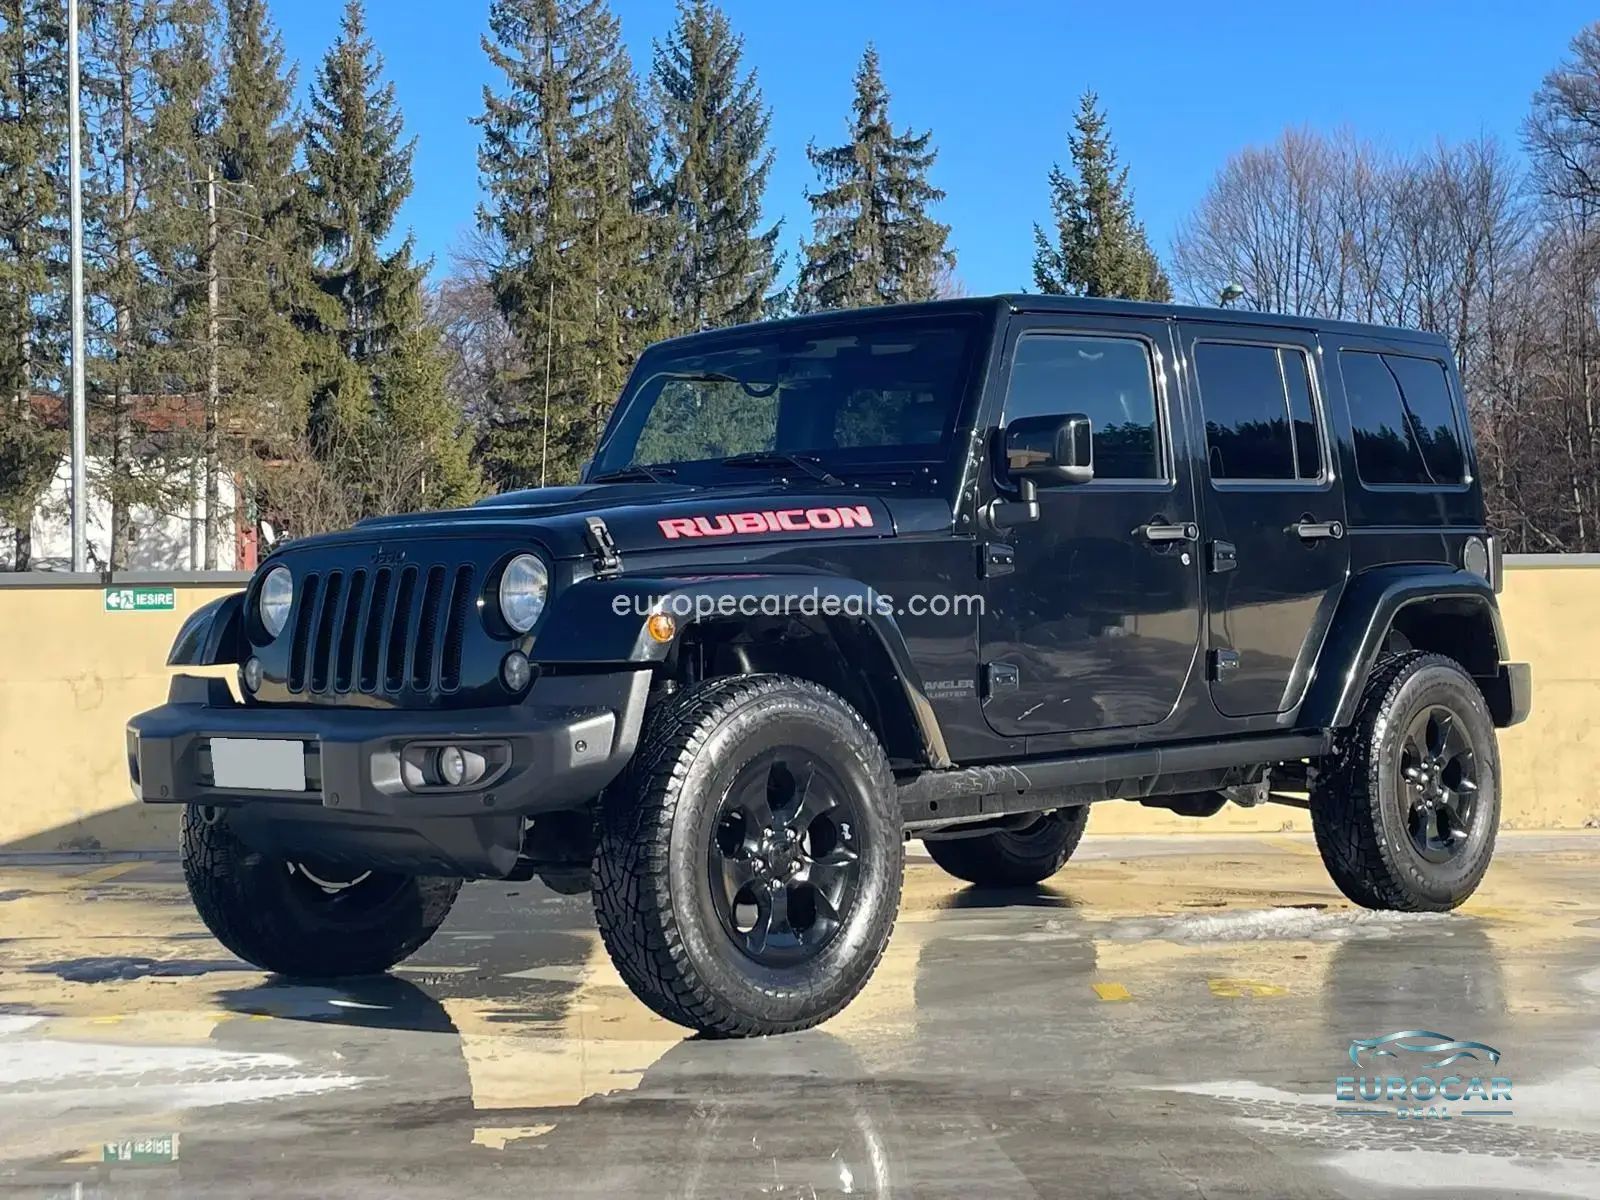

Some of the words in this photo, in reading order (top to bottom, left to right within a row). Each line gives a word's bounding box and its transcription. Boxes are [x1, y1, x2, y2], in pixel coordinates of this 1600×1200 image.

[658, 505, 874, 539] RUBICON
[136, 593, 173, 605] IESIRE
[923, 680, 975, 690] ANGLER
